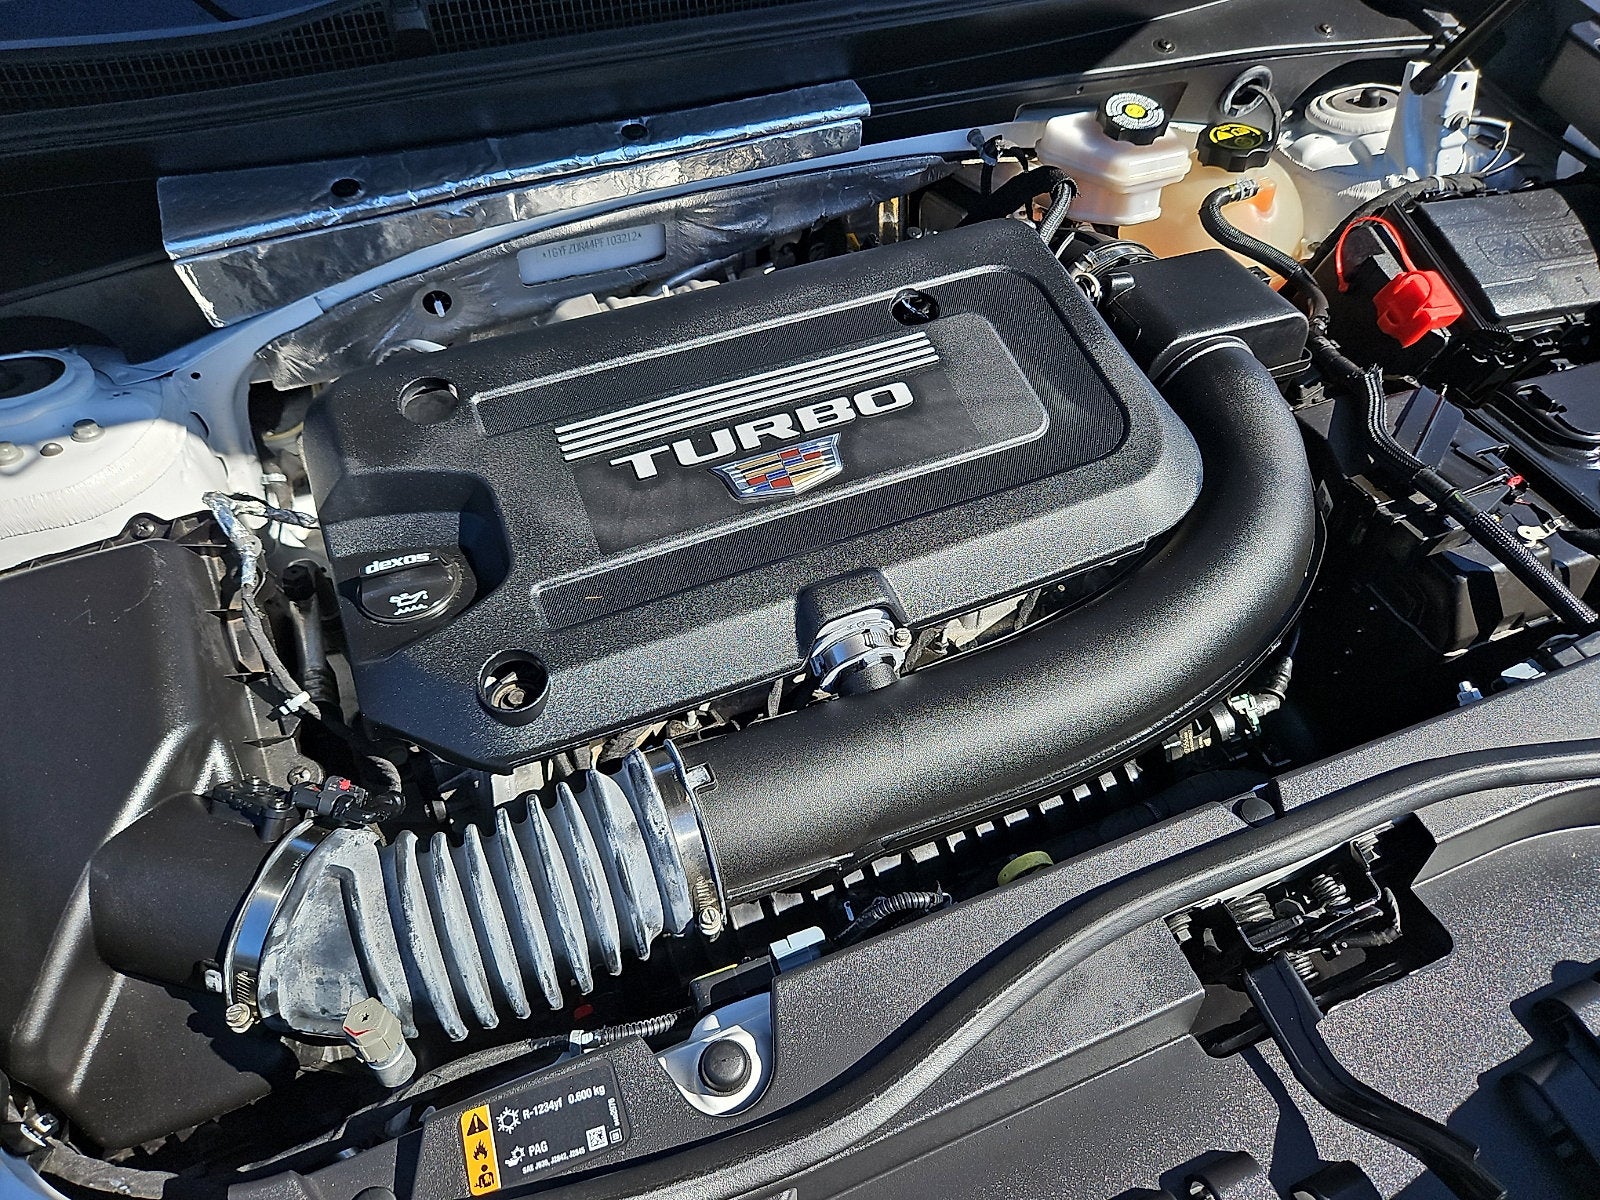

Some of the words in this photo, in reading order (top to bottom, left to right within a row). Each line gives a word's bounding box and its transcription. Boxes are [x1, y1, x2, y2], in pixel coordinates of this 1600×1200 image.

[609, 381, 915, 481] TURBO
[365, 552, 431, 575] dexos
[522, 1097, 563, 1120] R-1234yf
[568, 1088, 593, 1105] 0.600
[593, 1084, 606, 1096] kg
[528, 1140, 549, 1157] PAG
